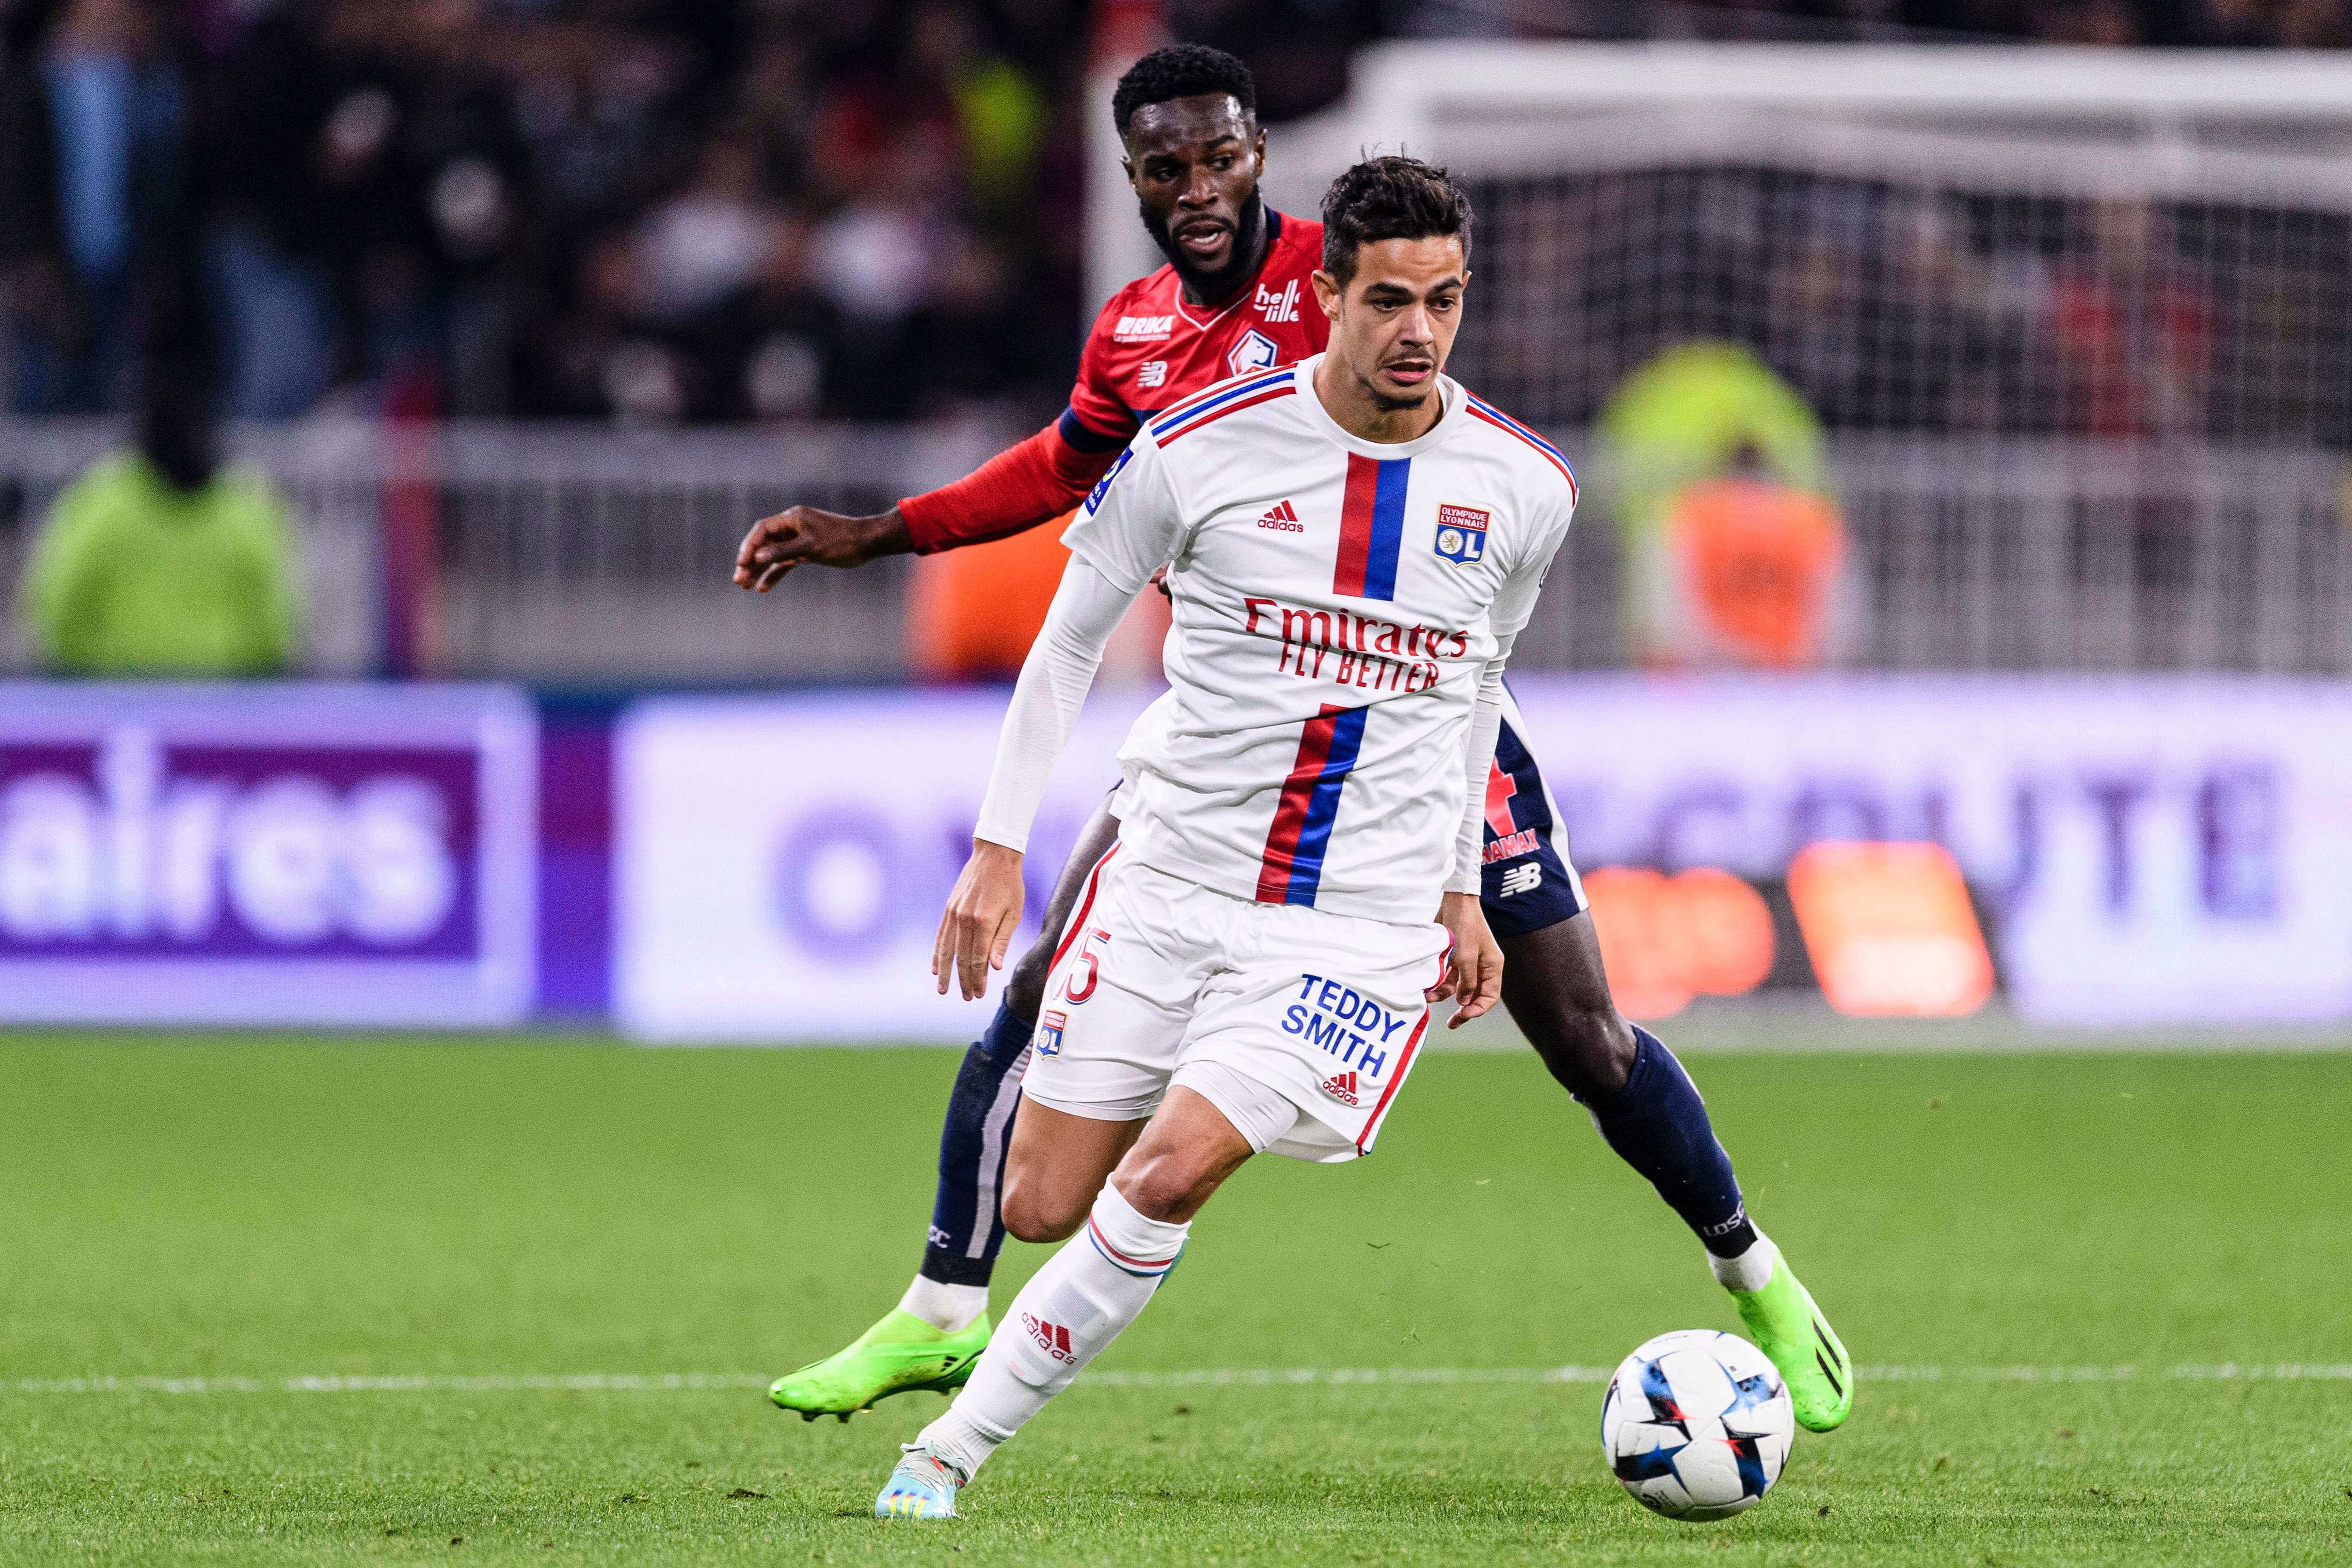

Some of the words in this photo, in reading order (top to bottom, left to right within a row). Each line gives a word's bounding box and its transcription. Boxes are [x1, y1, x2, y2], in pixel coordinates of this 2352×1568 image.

[1130, 315, 1176, 334] RIKA
[1257, 518, 1303, 533] adidas
[1440, 515, 1486, 528] LYONNAIS
[1441, 507, 1486, 521] OLYMPIQUE
[1438, 529, 1481, 558] OL
[1243, 597, 1468, 659] Emirates
[1279, 639, 1330, 679] FLY
[1336, 650, 1439, 693] BETTER
[0, 725, 453, 936] aires
[1053, 927, 1112, 1005] 5
[1300, 973, 1406, 1043] TEDDY
[1281, 1005, 1386, 1077] SMITH
[1323, 1081, 1359, 1106] adidas
[1022, 1312, 1077, 1365] adidas
